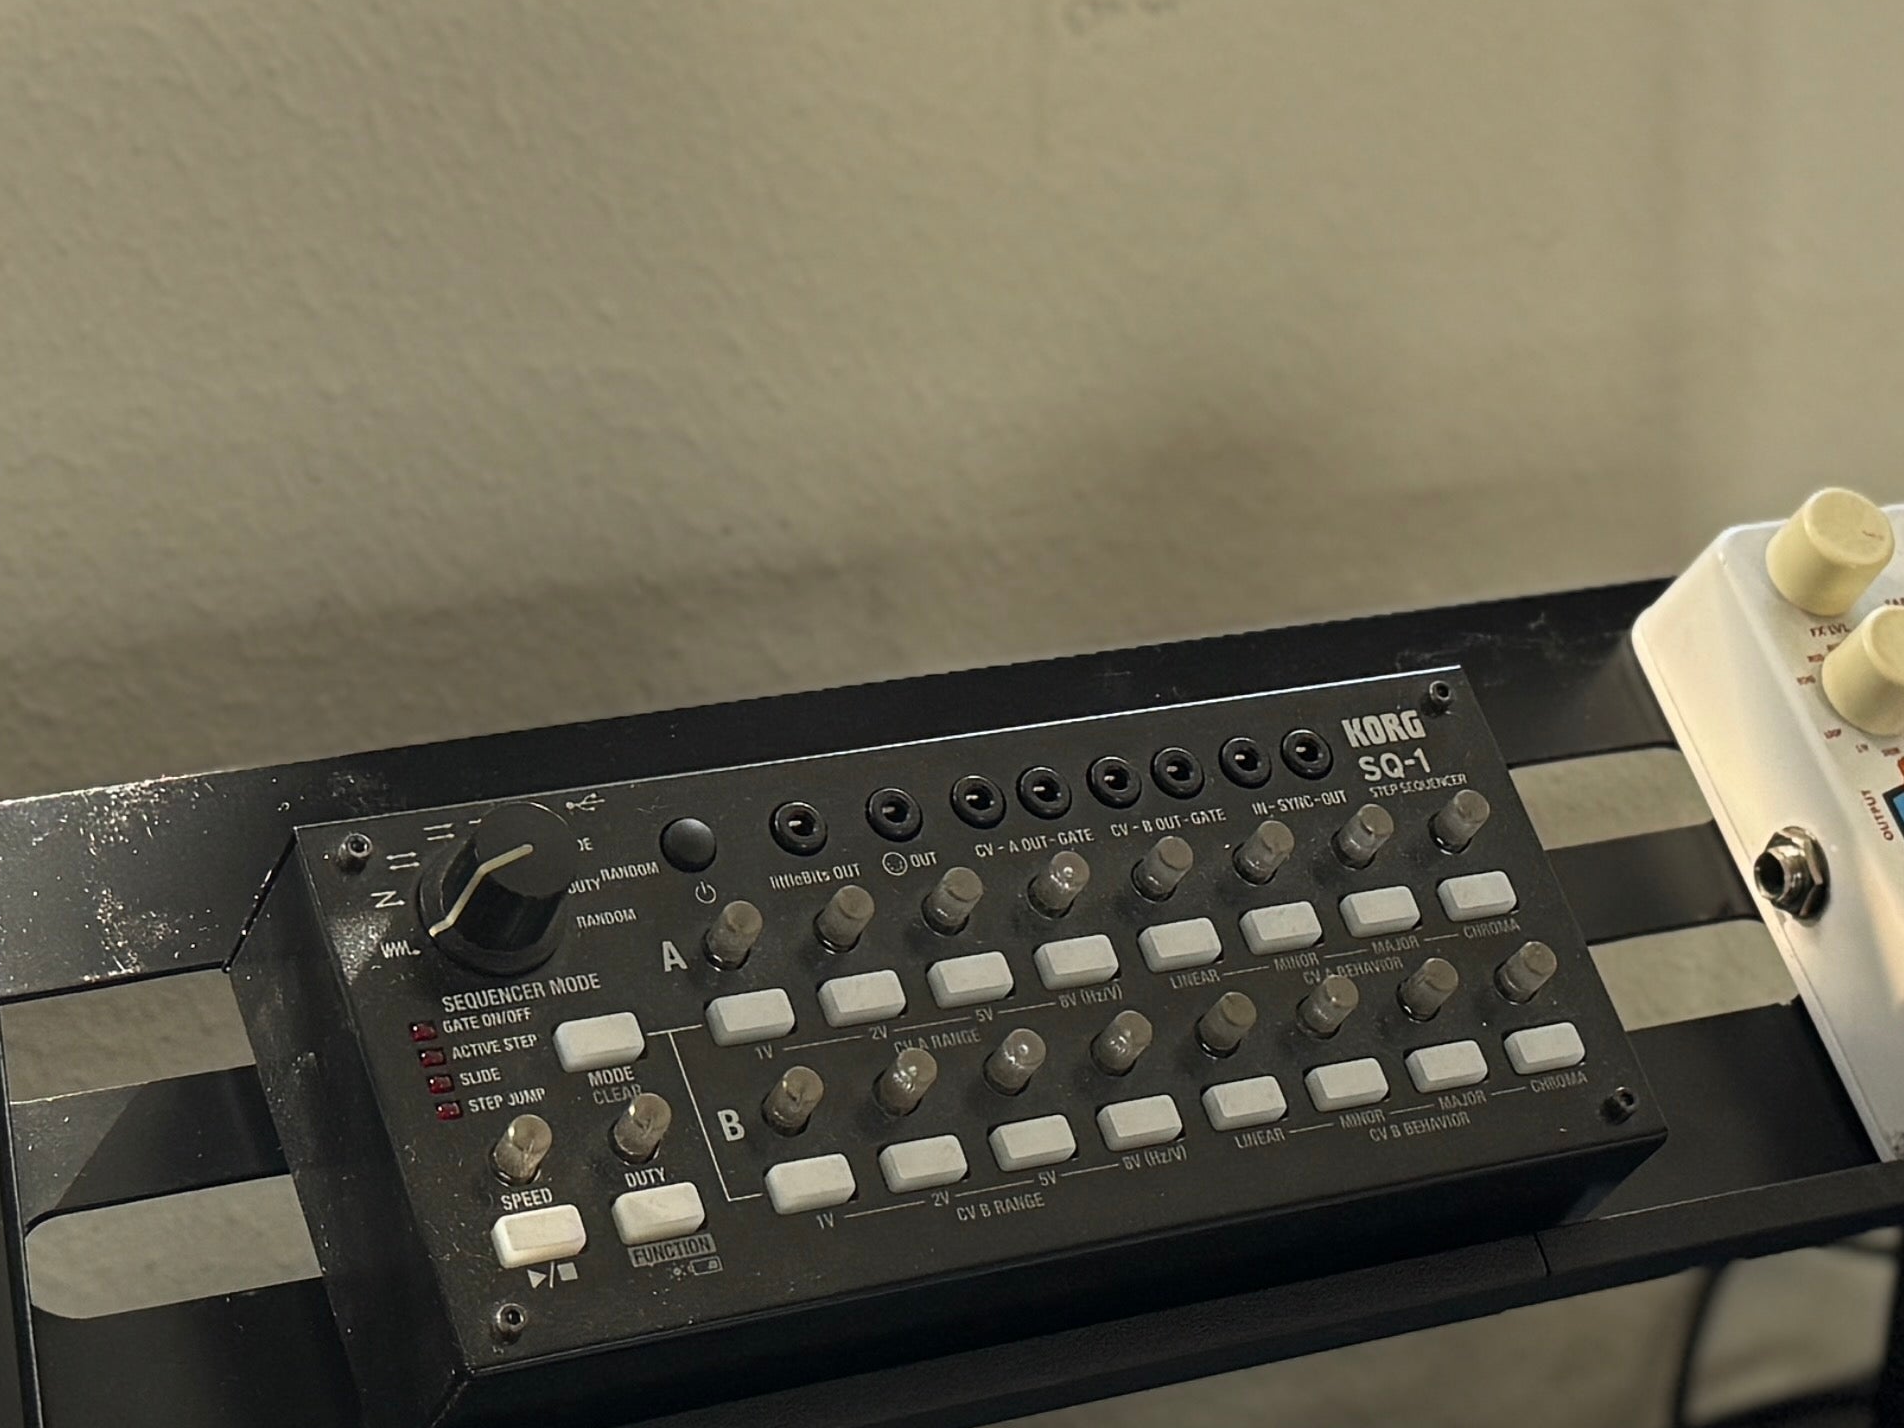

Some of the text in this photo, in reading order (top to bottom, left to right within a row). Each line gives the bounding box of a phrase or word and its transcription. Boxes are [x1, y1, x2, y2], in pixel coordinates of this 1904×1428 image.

[1341, 709, 1427, 748] KORG
[1358, 747, 1432, 783] SQ-1
[1369, 773, 1468, 799] STEP SEQUENCER
[1860, 789, 1895, 841] OUTPUT
[599, 860, 660, 883] RANDOM
[832, 862, 862, 881] OUT
[910, 851, 938, 869] OUT
[576, 907, 637, 930] RANDOM
[661, 940, 689, 973] A
[1169, 919, 1522, 990] LINEAR MINOR MAJOR CHROMA
[441, 972, 602, 1014] SEQUENCER MODE
[442, 1006, 533, 1035] GATE ON/OFF
[754, 1006, 995, 1061] 1V 2V 5V
[451, 1033, 539, 1060] ACTIVE STEP
[930, 1027, 982, 1048] RANGE
[459, 1067, 502, 1087] SLIDE
[586, 1065, 636, 1089] MODE
[467, 1087, 547, 1114] STEP JUMP
[591, 1083, 643, 1106] CLEAR
[1233, 1070, 1589, 1150] LINEAR MINOR MAJOR CHROMA
[1403, 1111, 1472, 1136] BEHAVIOR
[717, 1108, 746, 1143] B
[623, 1166, 667, 1189] DUTY
[499, 1186, 554, 1212] SPEED
[815, 1171, 1059, 1230] 1V 2V 5V
[955, 1191, 1047, 1223] CV RANGE
[630, 1238, 713, 1265] FUNCTION
